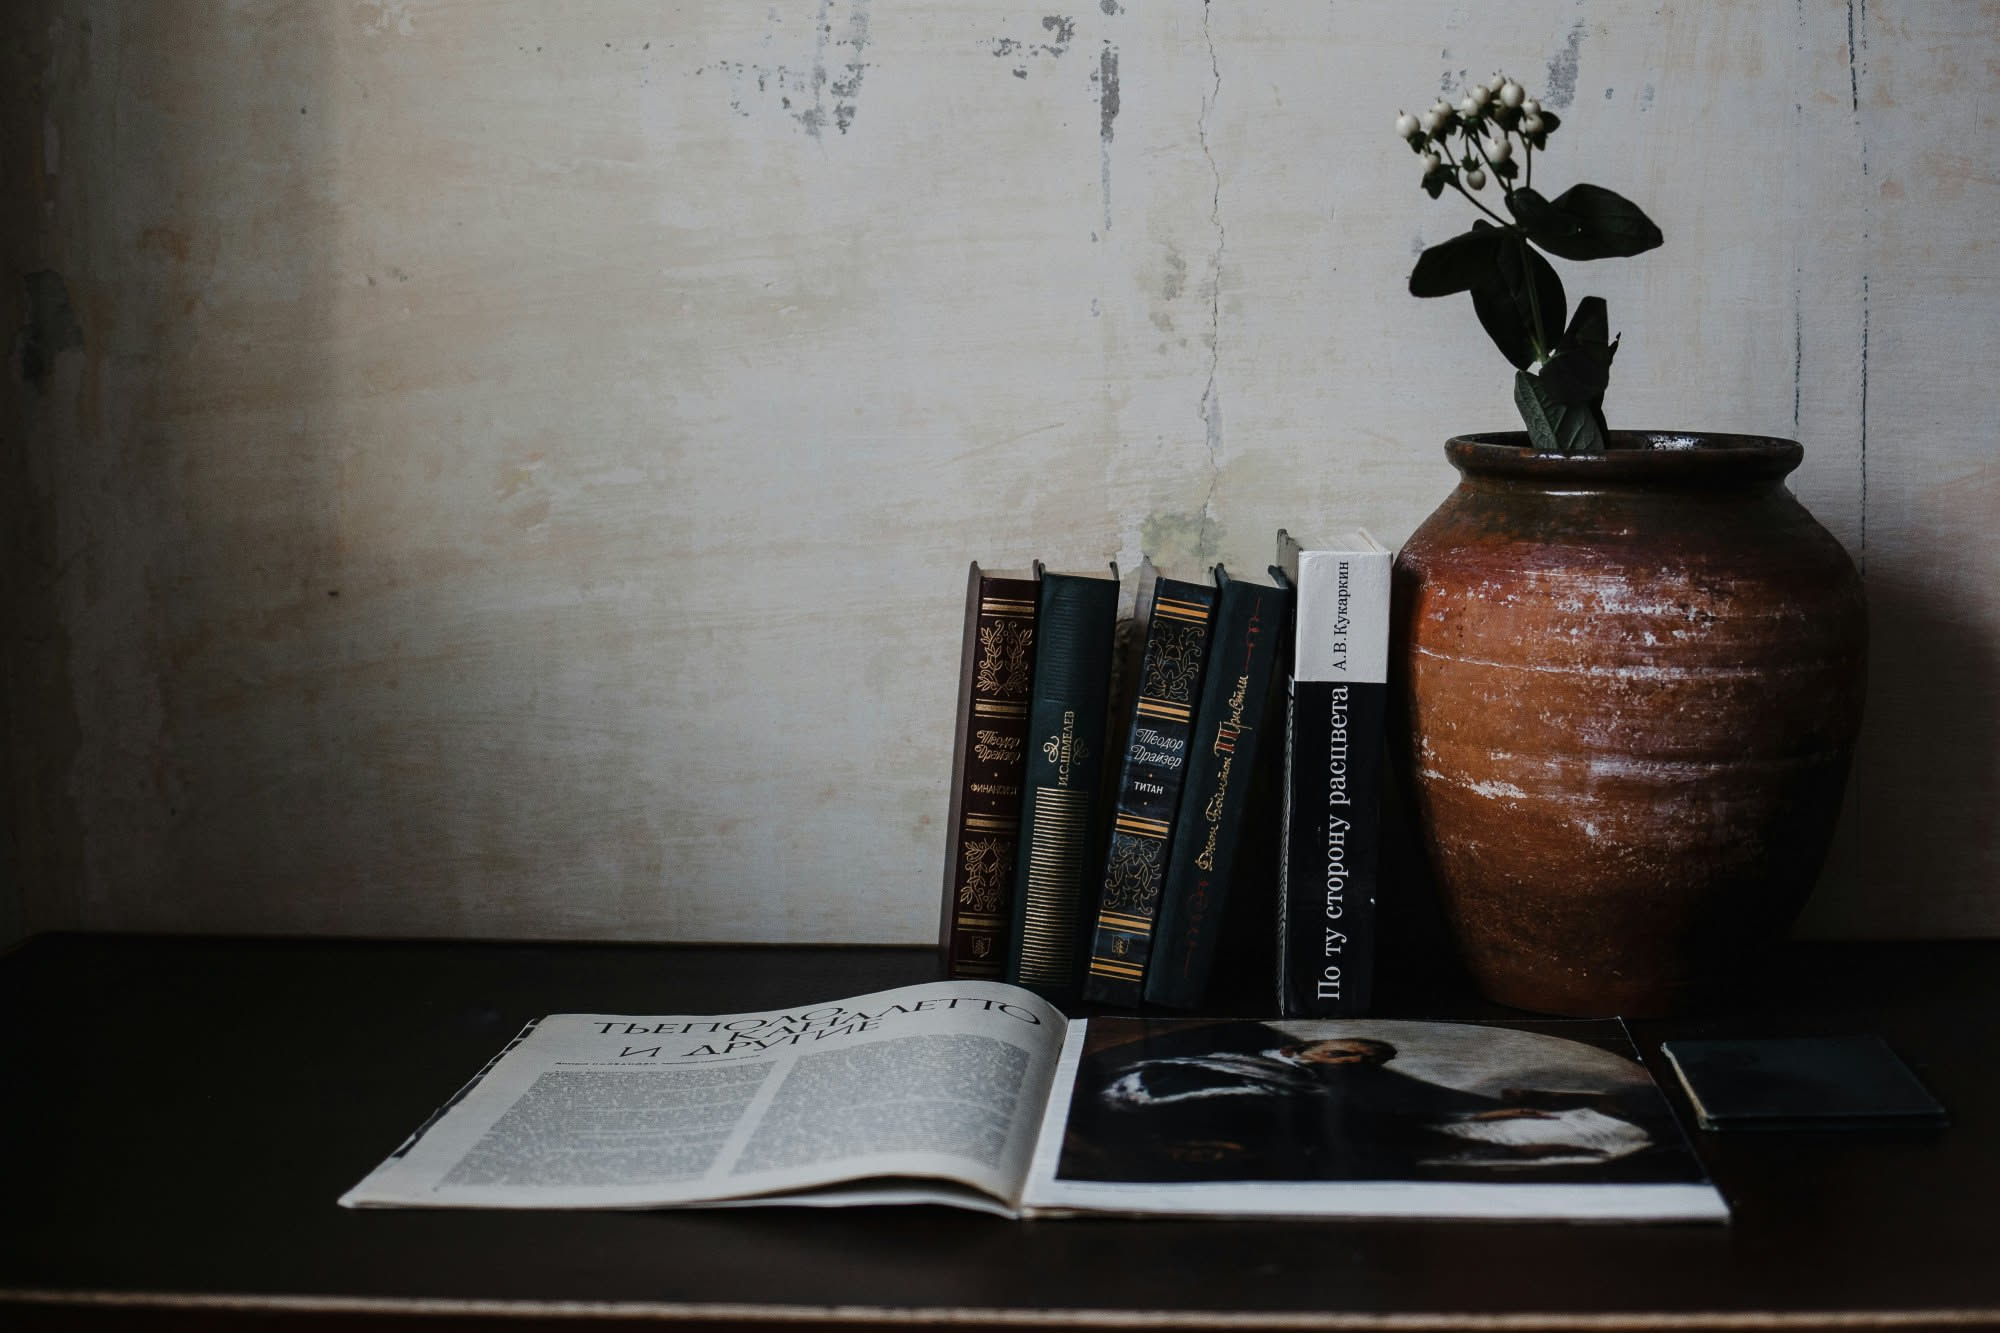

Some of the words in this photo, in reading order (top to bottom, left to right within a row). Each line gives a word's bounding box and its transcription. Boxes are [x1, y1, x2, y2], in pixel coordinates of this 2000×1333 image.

[975, 729, 1021, 750] Теодор
[1135, 728, 1184, 752] Теодор
[1329, 685, 1351, 806] расцвета
[1130, 744, 1182, 770] Драйзер
[1133, 781, 1163, 795] ТИТАН
[1326, 814, 1350, 919] сторону
[1325, 927, 1347, 957] ту
[1317, 966, 1341, 1000] По
[729, 998, 1041, 1042] КАНАЛЕТТО
[619, 1046, 662, 1058] И
[681, 1018, 880, 1057] ДРУГИЕ
